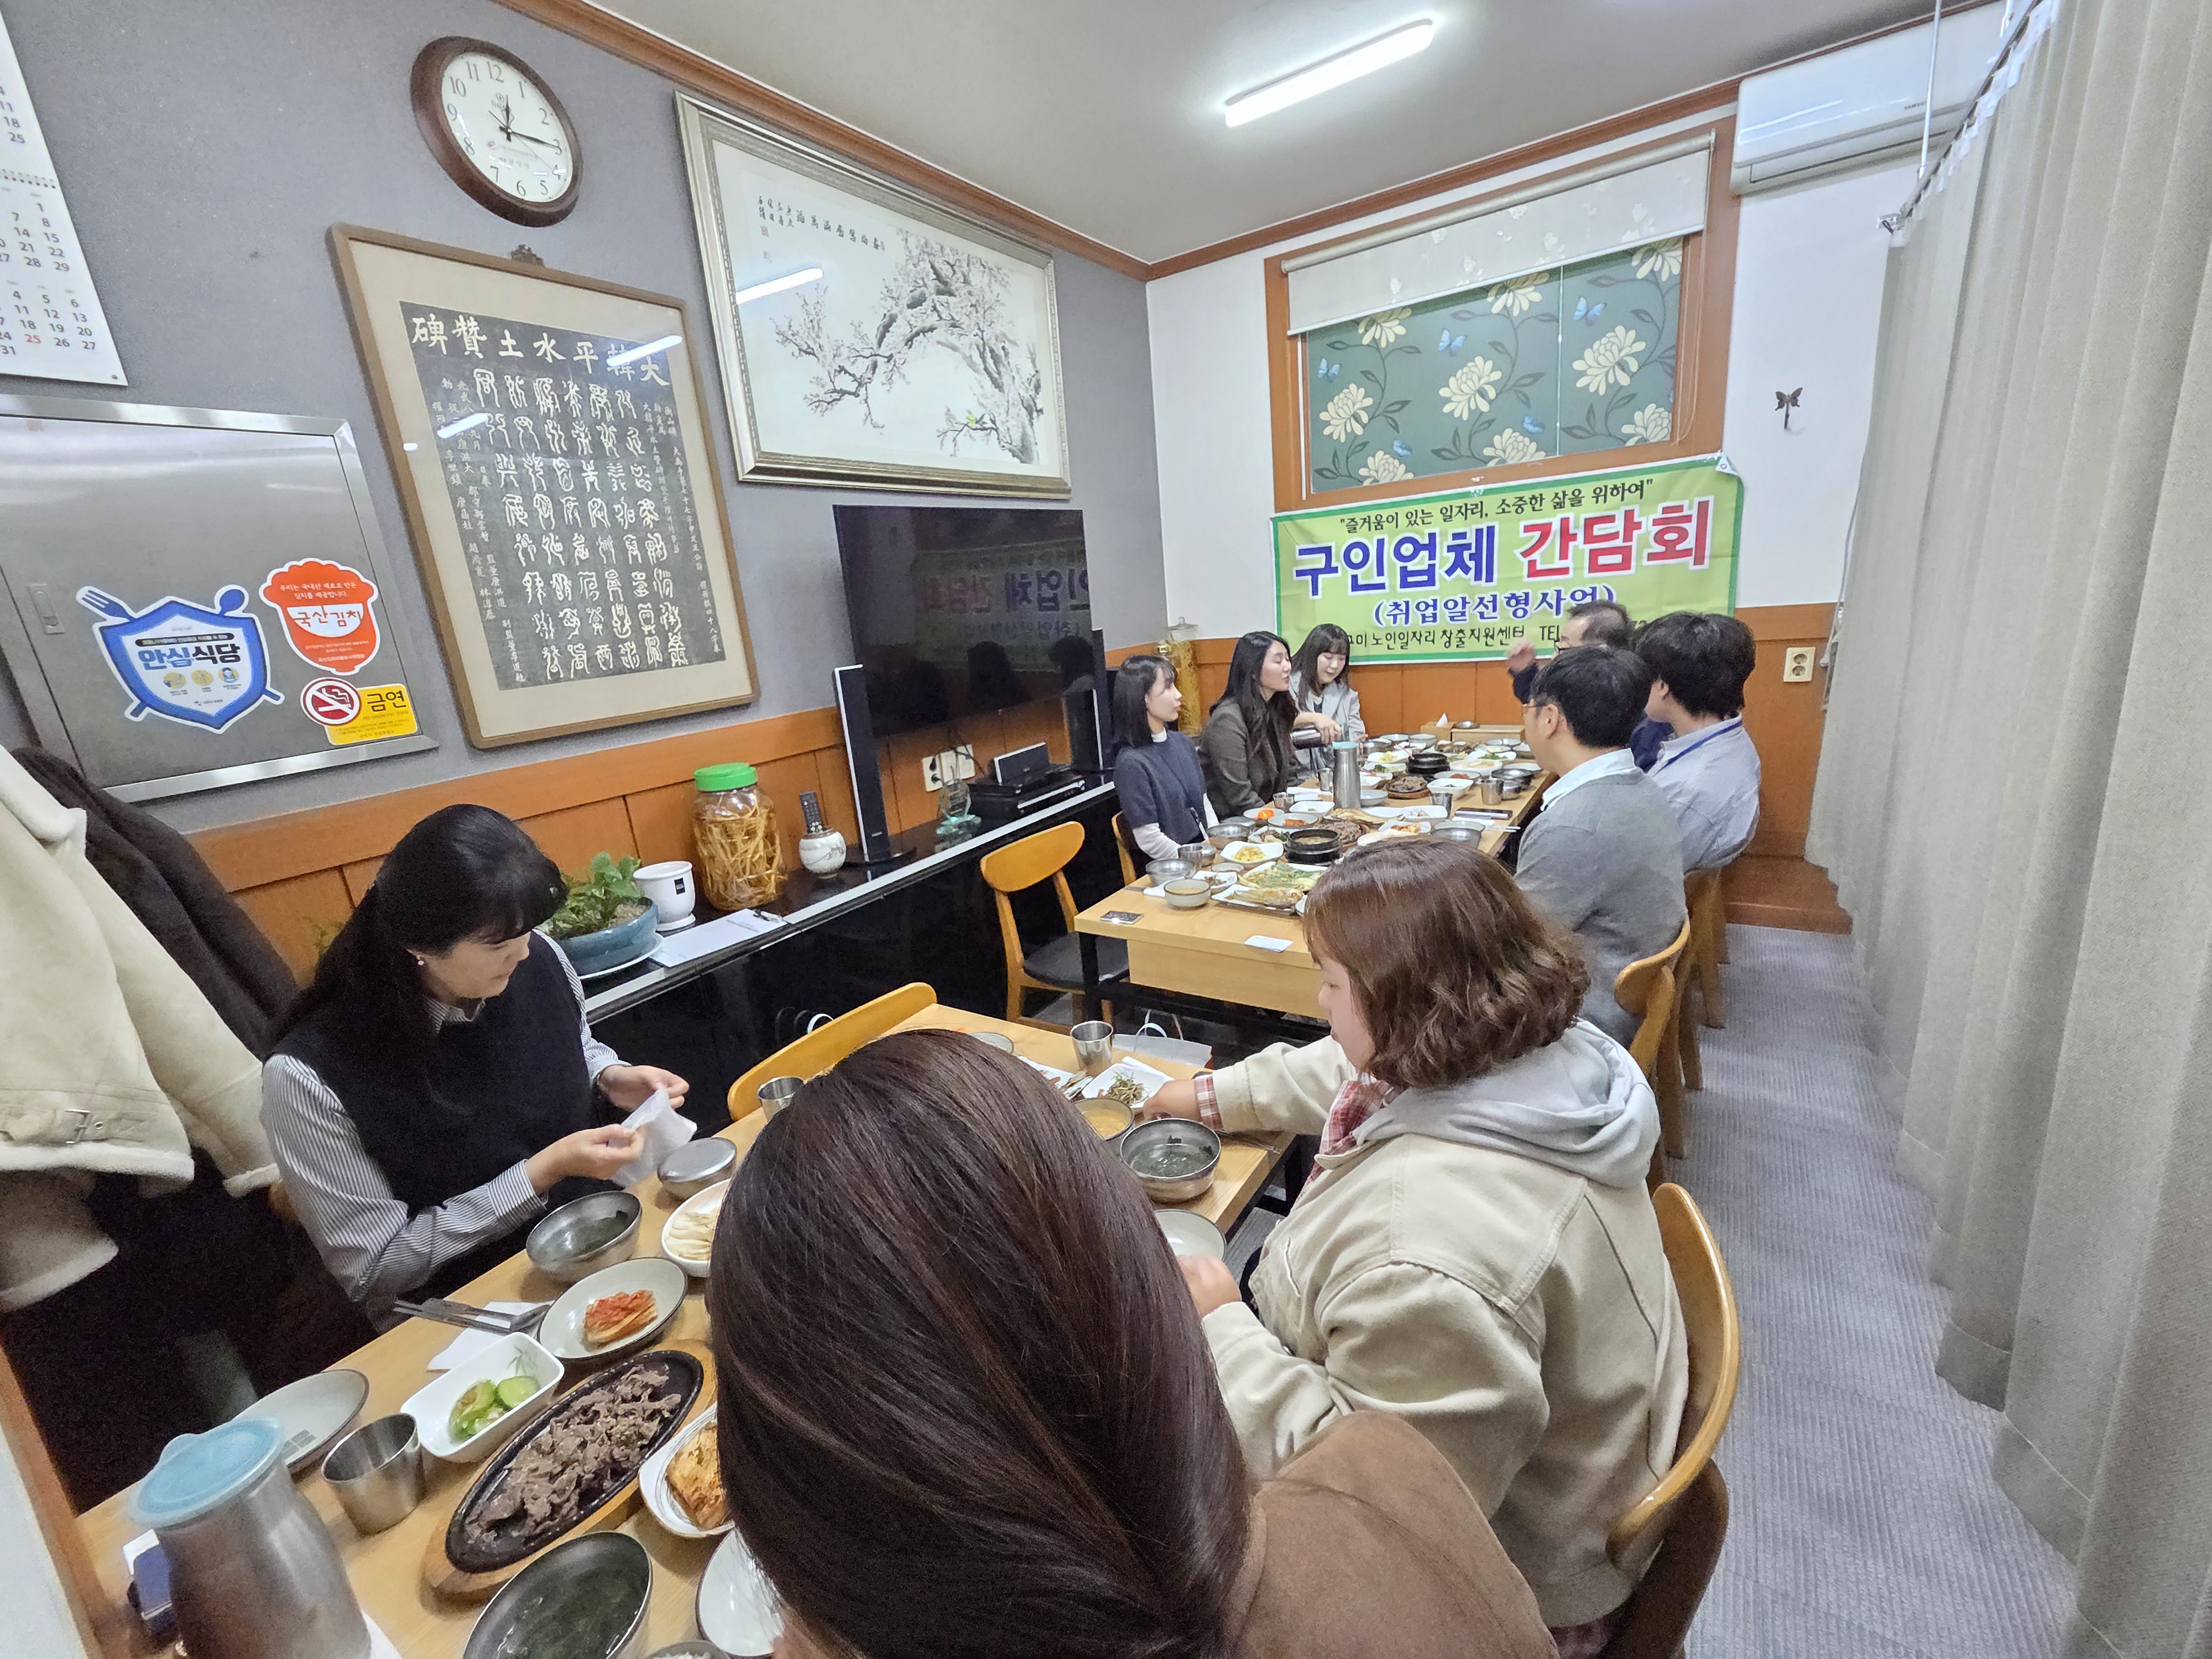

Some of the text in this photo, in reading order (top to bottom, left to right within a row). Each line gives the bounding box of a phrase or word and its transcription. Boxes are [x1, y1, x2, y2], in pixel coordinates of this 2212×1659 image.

[466, 61, 481, 81] 11
[487, 61, 504, 83] 12
[450, 76, 466, 97] 10
[518, 81, 526, 99] 1
[447, 103, 457, 121] 9
[1905, 100, 1927, 110] SAMSU
[3, 116, 20, 128] 18
[539, 107, 549, 125] 2
[8, 132, 25, 143] 25
[463, 137, 475, 155] 8
[552, 139, 562, 155] 3
[490, 165, 498, 182] 7
[516, 180, 525, 196] 6
[540, 180, 548, 195] 5
[36, 203, 44, 212] 1
[11, 212, 50, 227] 7 8
[13, 227, 59, 243] 14 15
[18, 242, 34, 252] 21
[48, 247, 65, 258] 22
[24, 257, 41, 267] 28
[53, 262, 70, 272] 29
[13, 291, 79, 307] 4 5 6
[14, 305, 87, 322] 11 12 13
[20, 320, 36, 330] 18
[49, 323, 64, 332] 19
[76, 326, 92, 336] 20
[24, 333, 41, 344] 25
[53, 337, 70, 347] 26
[81, 341, 96, 350] 27
[0, 345, 16, 356] 31
[1340, 478, 1653, 534] "즐거움이 있는 일자리, 소중한 삶을 위하여"
[1295, 500, 1710, 597] 구인업체 간담회
[292, 606, 361, 628] 국산김치
[138, 643, 241, 671] 안심식당
[367, 690, 407, 712] 금연
